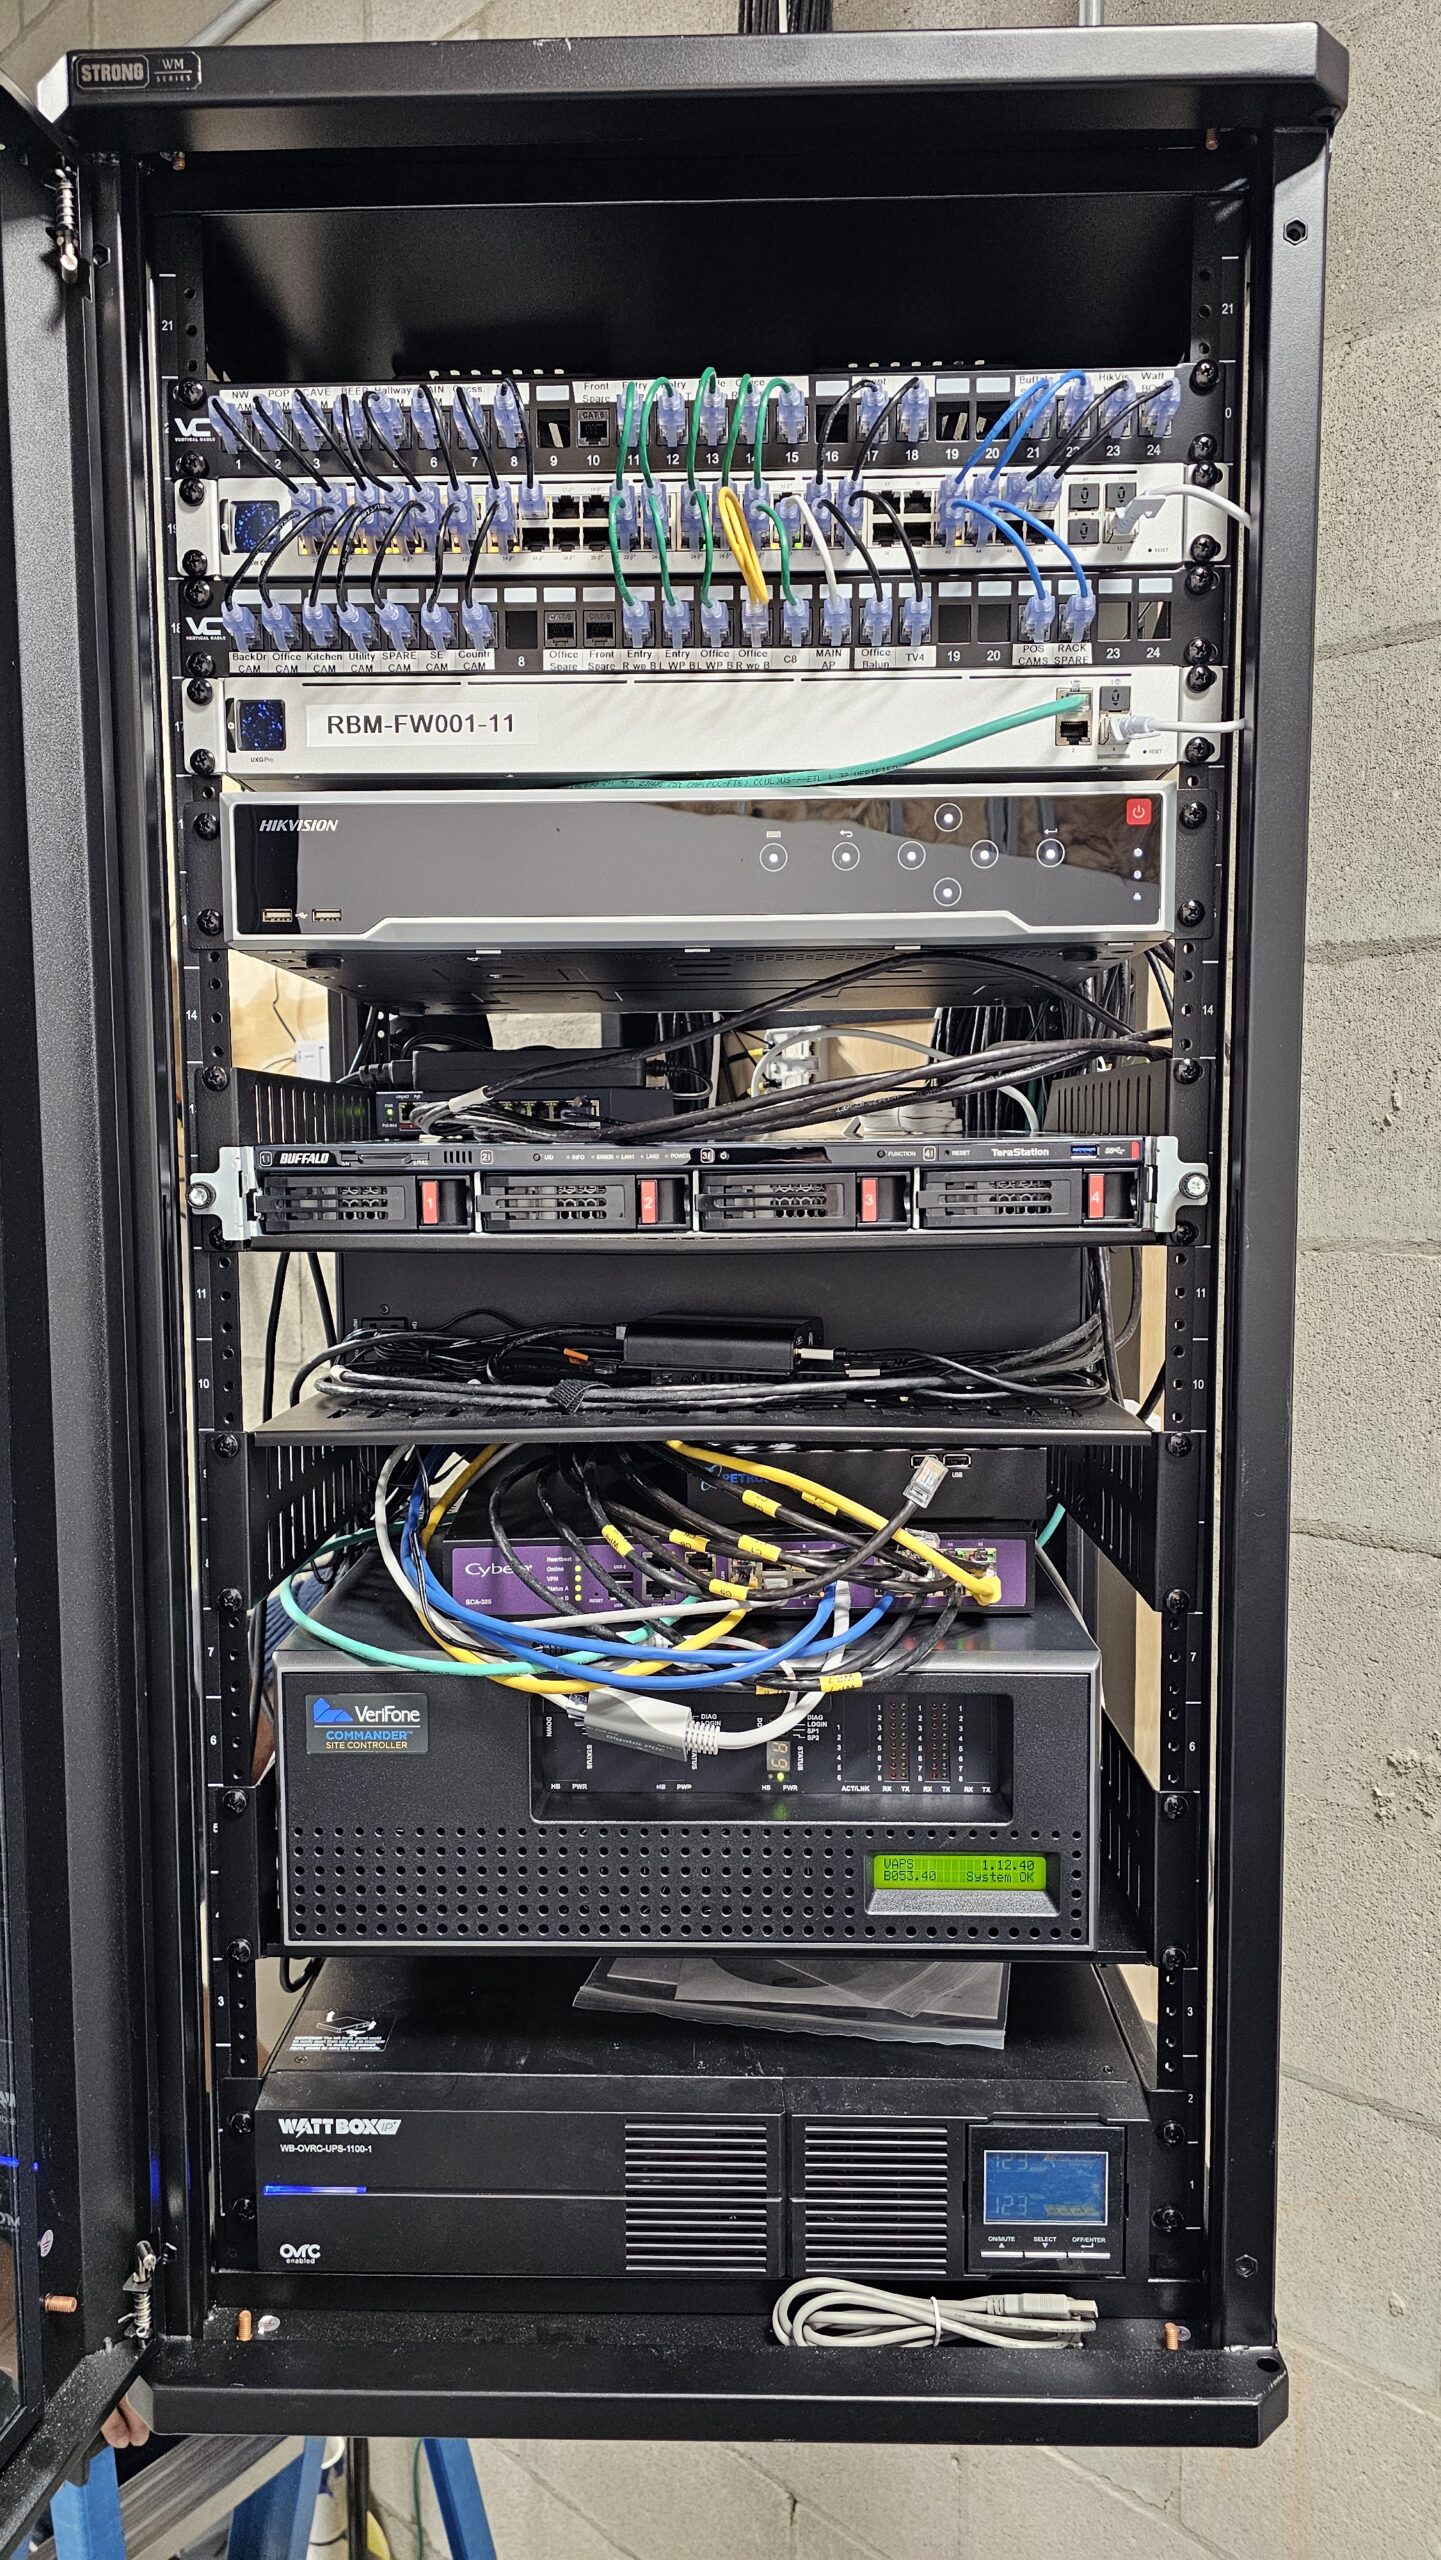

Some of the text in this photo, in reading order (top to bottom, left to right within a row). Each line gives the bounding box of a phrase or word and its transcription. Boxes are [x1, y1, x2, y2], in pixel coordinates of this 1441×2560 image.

[162, 58, 184, 70] WM
[81, 63, 144, 82] STRONG
[1221, 303, 1234, 315] 21
[161, 320, 173, 331] 21
[584, 383, 610, 391] Front
[232, 391, 250, 399] NW
[268, 389, 290, 398] POP
[174, 418, 212, 437] VC
[905, 450, 919, 461] 18
[945, 449, 959, 460] 19
[985, 448, 1000, 459] 20
[1026, 448, 1040, 459] 21
[1106, 446, 1121, 457] 23
[1146, 445, 1161, 456] 24
[430, 456, 438, 468] 6
[470, 456, 478, 467] 7
[510, 456, 518, 467] 8
[550, 456, 558, 467] 9
[586, 454, 600, 466] 10
[627, 454, 640, 465] 11
[666, 453, 680, 465] 12
[705, 453, 720, 464] 13
[785, 452, 799, 463] 15
[825, 452, 839, 463] 16
[235, 459, 241, 470] 1
[274, 459, 282, 470] 2
[313, 458, 321, 469] 3
[186, 617, 223, 635] VC
[589, 650, 614, 658] Front
[700, 649, 730, 658] Office
[739, 649, 768, 658] Office
[816, 649, 842, 657] MAIN
[861, 648, 891, 657] Office
[1022, 644, 1045, 653] POS
[1057, 644, 1087, 653] RACK
[1106, 648, 1121, 658] 23
[1146, 647, 1161, 658] 24
[232, 653, 267, 661] BackDr
[272, 652, 302, 661] Office
[306, 652, 342, 661] Kitchen
[349, 652, 376, 662] Utility
[382, 651, 417, 660] SPARE
[430, 651, 443, 660] SE
[458, 651, 490, 659] Countr
[549, 651, 579, 659] Office
[627, 650, 653, 660] Entry
[665, 649, 690, 660] Entry
[784, 655, 797, 663] C8
[906, 653, 925, 662] TV4
[947, 651, 961, 662] 19
[986, 650, 1001, 661] 20
[1054, 655, 1090, 665] SPARE
[517, 656, 526, 667] 8
[588, 662, 616, 670] Spare
[821, 661, 836, 669] AP
[1018, 656, 1049, 665] CAMS
[238, 665, 261, 673] CAM
[275, 665, 298, 673] CAM
[312, 664, 336, 673] CAM
[351, 664, 373, 673] CAM
[388, 664, 411, 672] CAM
[425, 663, 448, 672] CAM
[463, 662, 486, 671] CAM
[550, 663, 578, 671] Spare
[326, 713, 515, 735] RBM-FW001-11
[259, 819, 339, 832] HIKVISION
[186, 1010, 197, 1020] 14
[1202, 1004, 1213, 1015] 14
[280, 1152, 329, 1164] BUFFALO
[991, 1148, 1049, 1157] TeraStation
[643, 1197, 652, 1209] 2
[865, 1194, 873, 1205] 3
[1092, 1192, 1100, 1203] 4
[427, 1198, 433, 1209] 1
[196, 1288, 207, 1299] 11
[1195, 1288, 1206, 1298] 11
[198, 1378, 209, 1389] 10
[1192, 1380, 1204, 1390] 10
[207, 1646, 214, 1657] 7
[1190, 1652, 1197, 1662] 7
[354, 1705, 421, 1722] VeriFone
[210, 1735, 217, 1746] 6
[325, 1741, 408, 1750] SITE CONTROLLER
[1189, 1741, 1196, 1752] 6
[883, 1858, 1035, 1870] VAPS 1.12.40
[884, 1871, 1034, 1882] B053.40 System OK
[218, 1996, 225, 2007] 3
[1187, 2006, 1193, 2017] 3
[1187, 2093, 1194, 2104] 2
[280, 2144, 373, 2153] WB-OVRC-UPS-1100-1
[1189, 2180, 1195, 2190] 1
